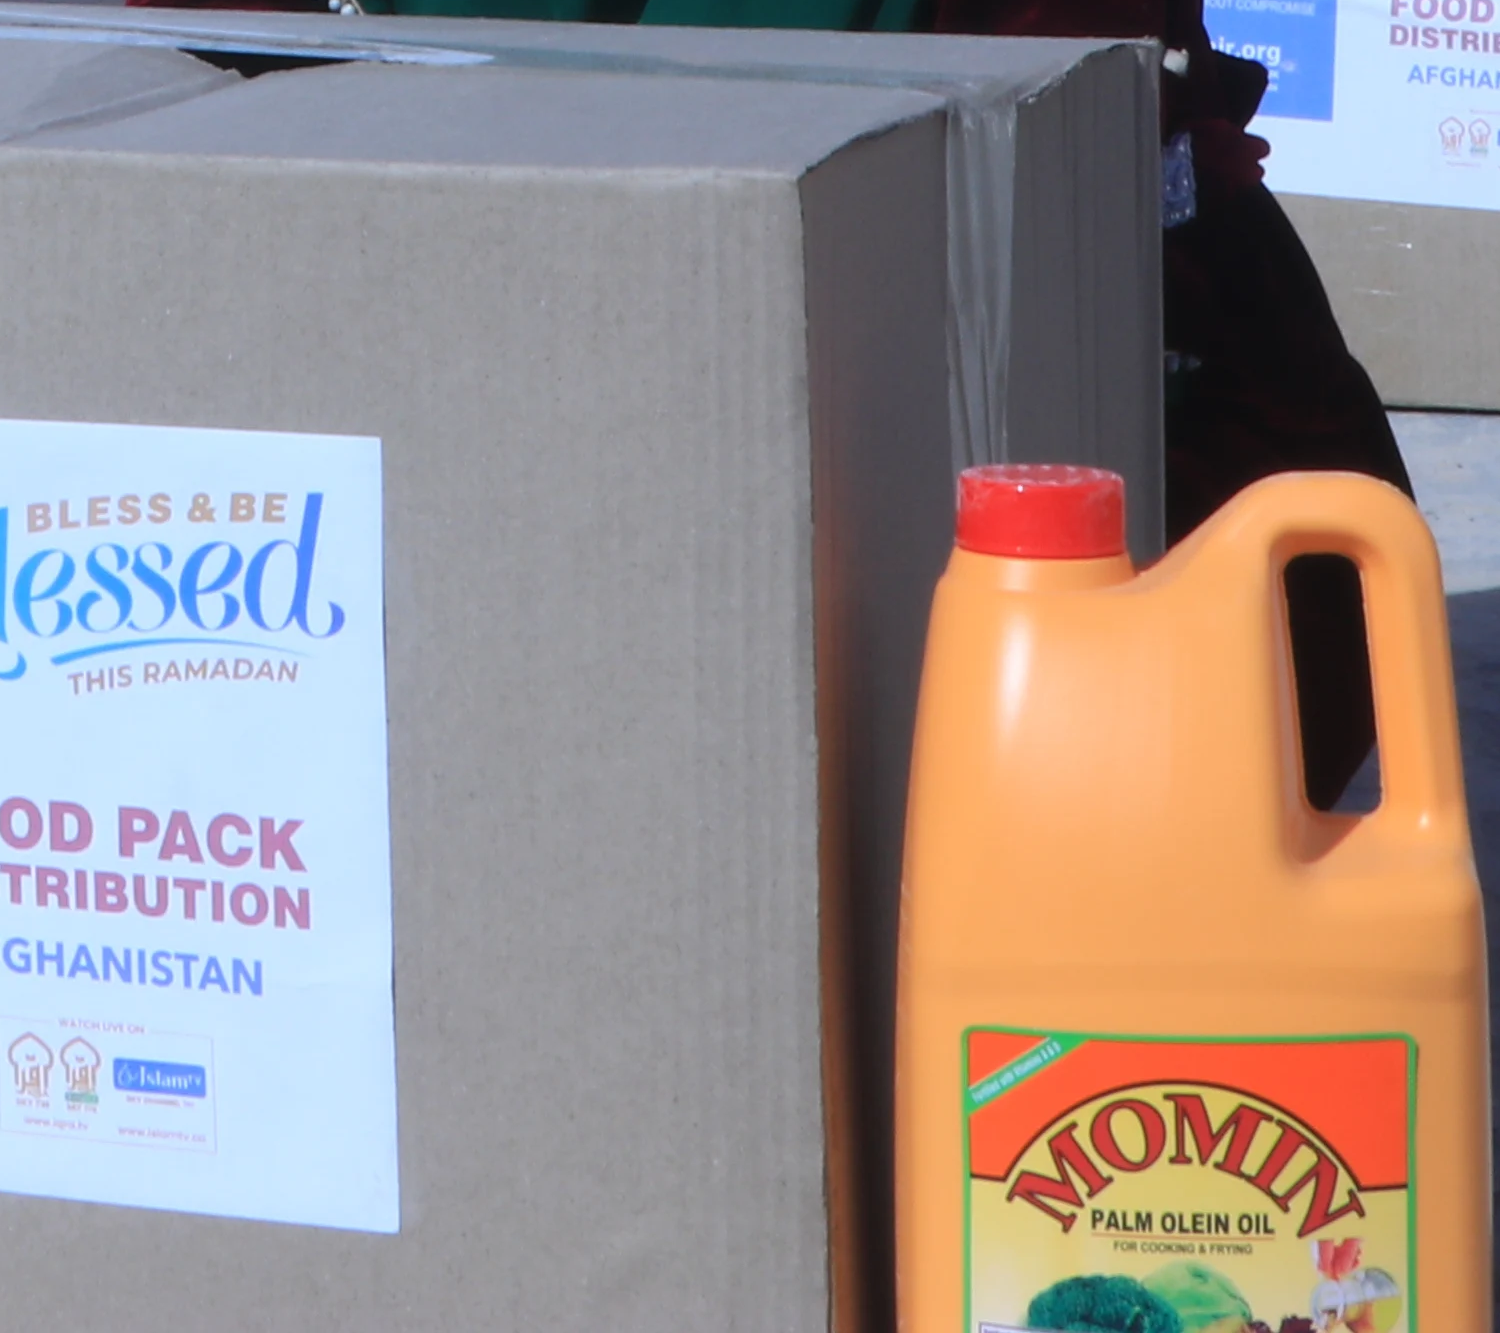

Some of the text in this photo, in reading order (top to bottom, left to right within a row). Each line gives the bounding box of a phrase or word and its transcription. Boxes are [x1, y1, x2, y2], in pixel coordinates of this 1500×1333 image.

[26, 492, 288, 534] BLESS & BE
[68, 658, 300, 696] THIS RAMADAN
[118, 806, 308, 873] PACK
[58, 1018, 145, 1035] WATCH LIVE ON
[1005, 1092, 1366, 1239] MOMIN
[1091, 1209, 1275, 1235] PALM OLEIN OIL
[1113, 1240, 1138, 1254] FOR
[1140, 1241, 1195, 1255] COOKING
[1210, 1243, 1253, 1257] FRYING
